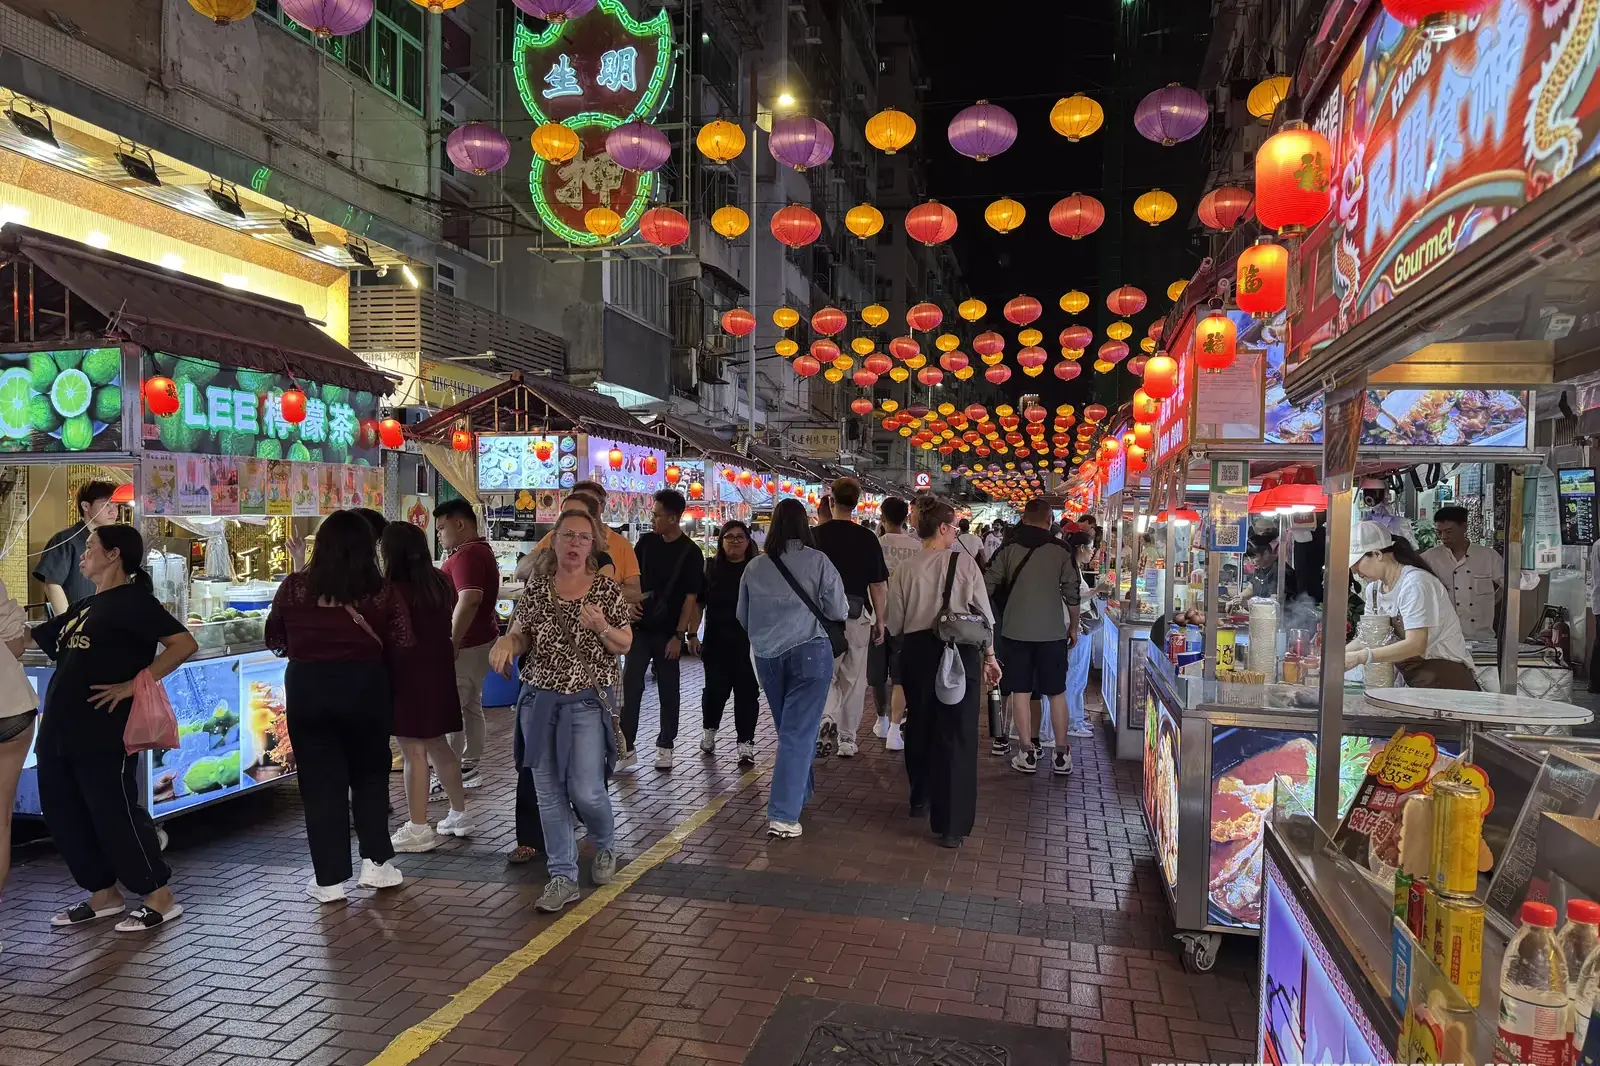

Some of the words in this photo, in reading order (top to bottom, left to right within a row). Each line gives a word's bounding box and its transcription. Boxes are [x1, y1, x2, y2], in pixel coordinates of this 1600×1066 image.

[1391, 38, 1433, 120] Hong
[1393, 213, 1457, 284] Gourmet
[184, 382, 259, 434] LEE
[920, 475, 928, 485] K
